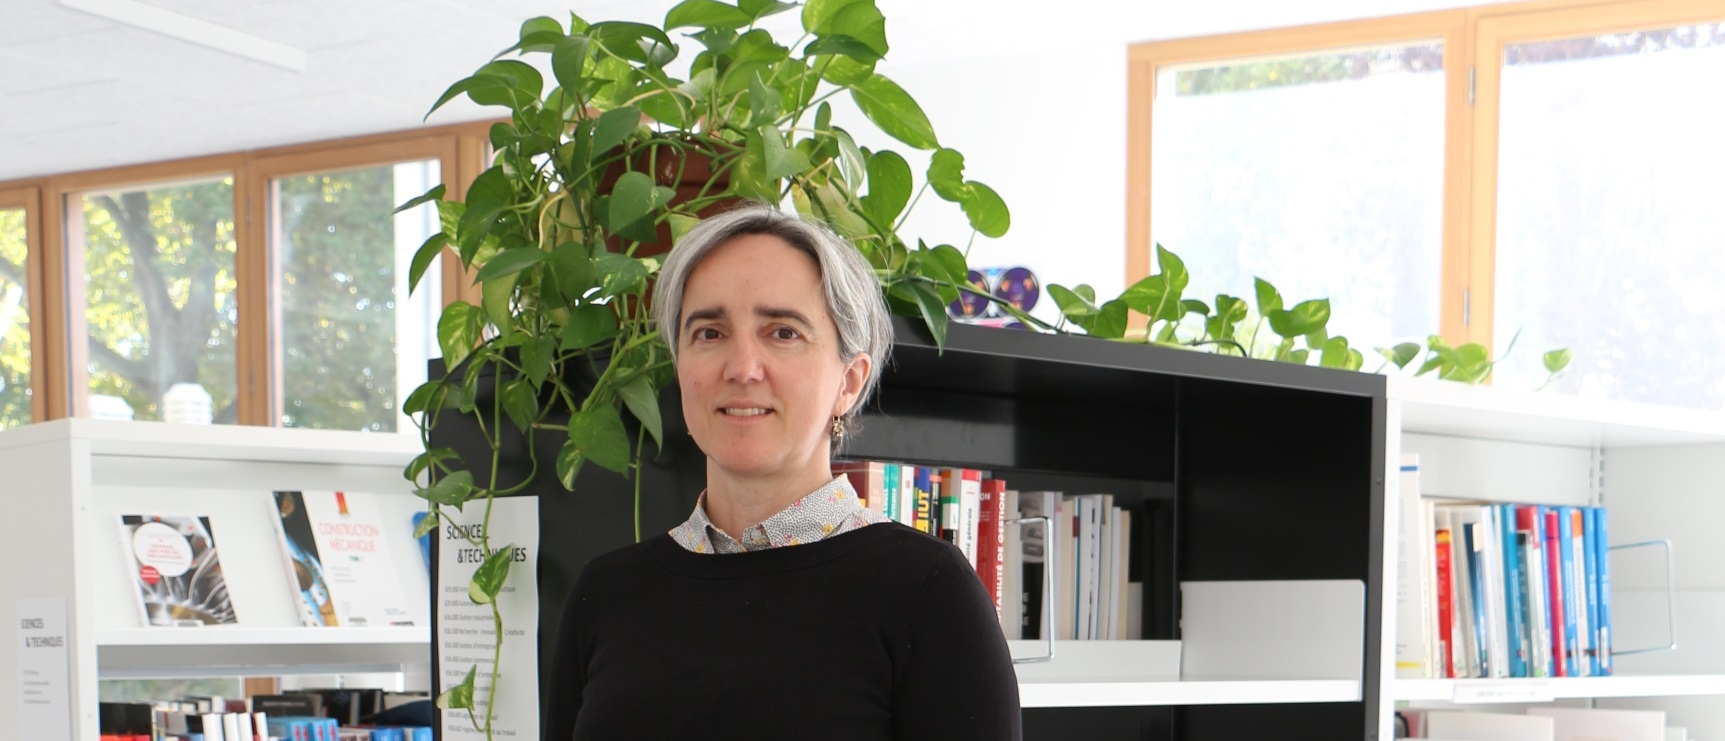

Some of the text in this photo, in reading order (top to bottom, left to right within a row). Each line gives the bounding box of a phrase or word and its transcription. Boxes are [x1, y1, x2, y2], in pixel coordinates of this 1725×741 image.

[918, 490, 929, 517] IUT
[980, 492, 991, 501] ON
[319, 523, 379, 536] CONSTRUCTION
[446, 524, 490, 539] SCIENCE
[330, 538, 376, 552] MÉCANIQUE
[995, 492, 1005, 622] PTABILITÉ DE GESTION
